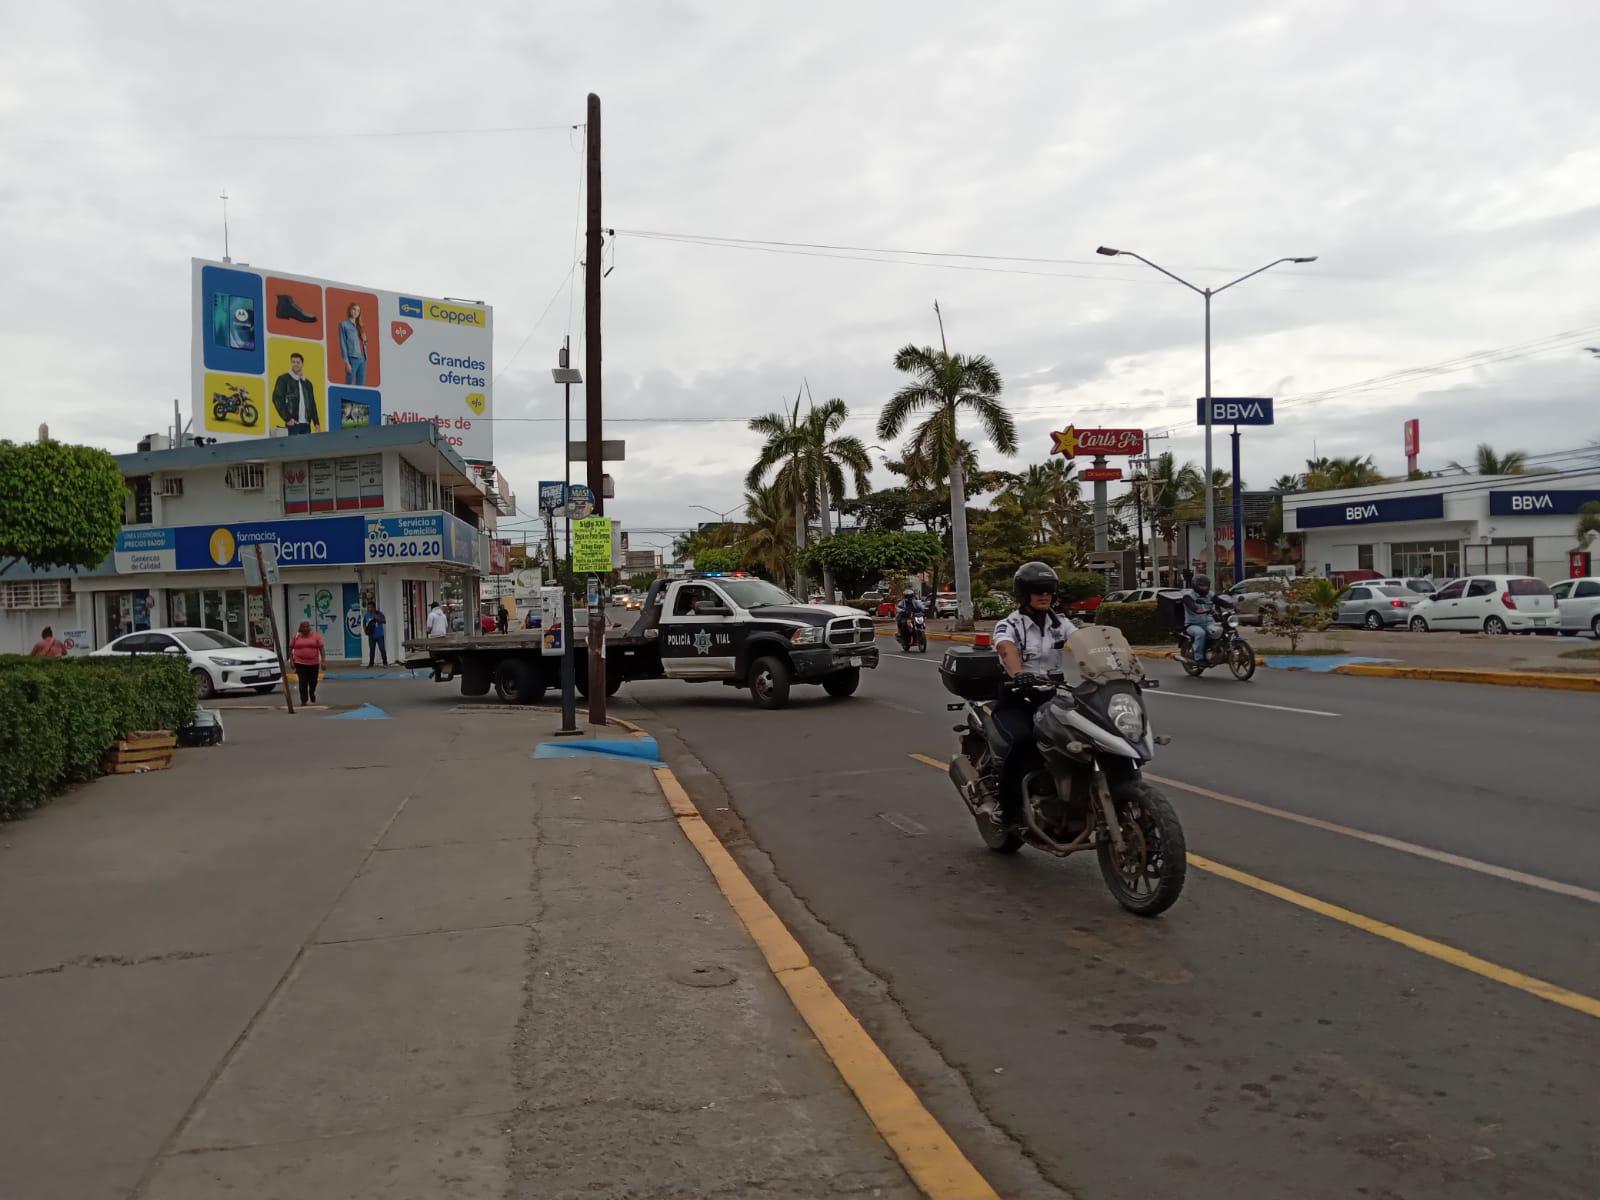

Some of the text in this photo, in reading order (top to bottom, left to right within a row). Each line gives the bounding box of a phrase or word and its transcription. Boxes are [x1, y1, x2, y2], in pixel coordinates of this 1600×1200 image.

[429, 304, 481, 325] Coppel
[428, 351, 486, 371] Grandes
[439, 370, 486, 387] ofertas
[1213, 401, 1264, 420] BBVA
[455, 416, 472, 430] de
[1078, 431, 1117, 448] Carl's
[1512, 494, 1553, 511] BBVA
[1346, 503, 1379, 520] BBVA
[398, 519, 430, 528] Servicio
[403, 527, 438, 536] Domicilio
[236, 530, 277, 542] farmacias
[369, 540, 441, 558] 990.20.20
[667, 632, 731, 646] POLICÍA VIAL
